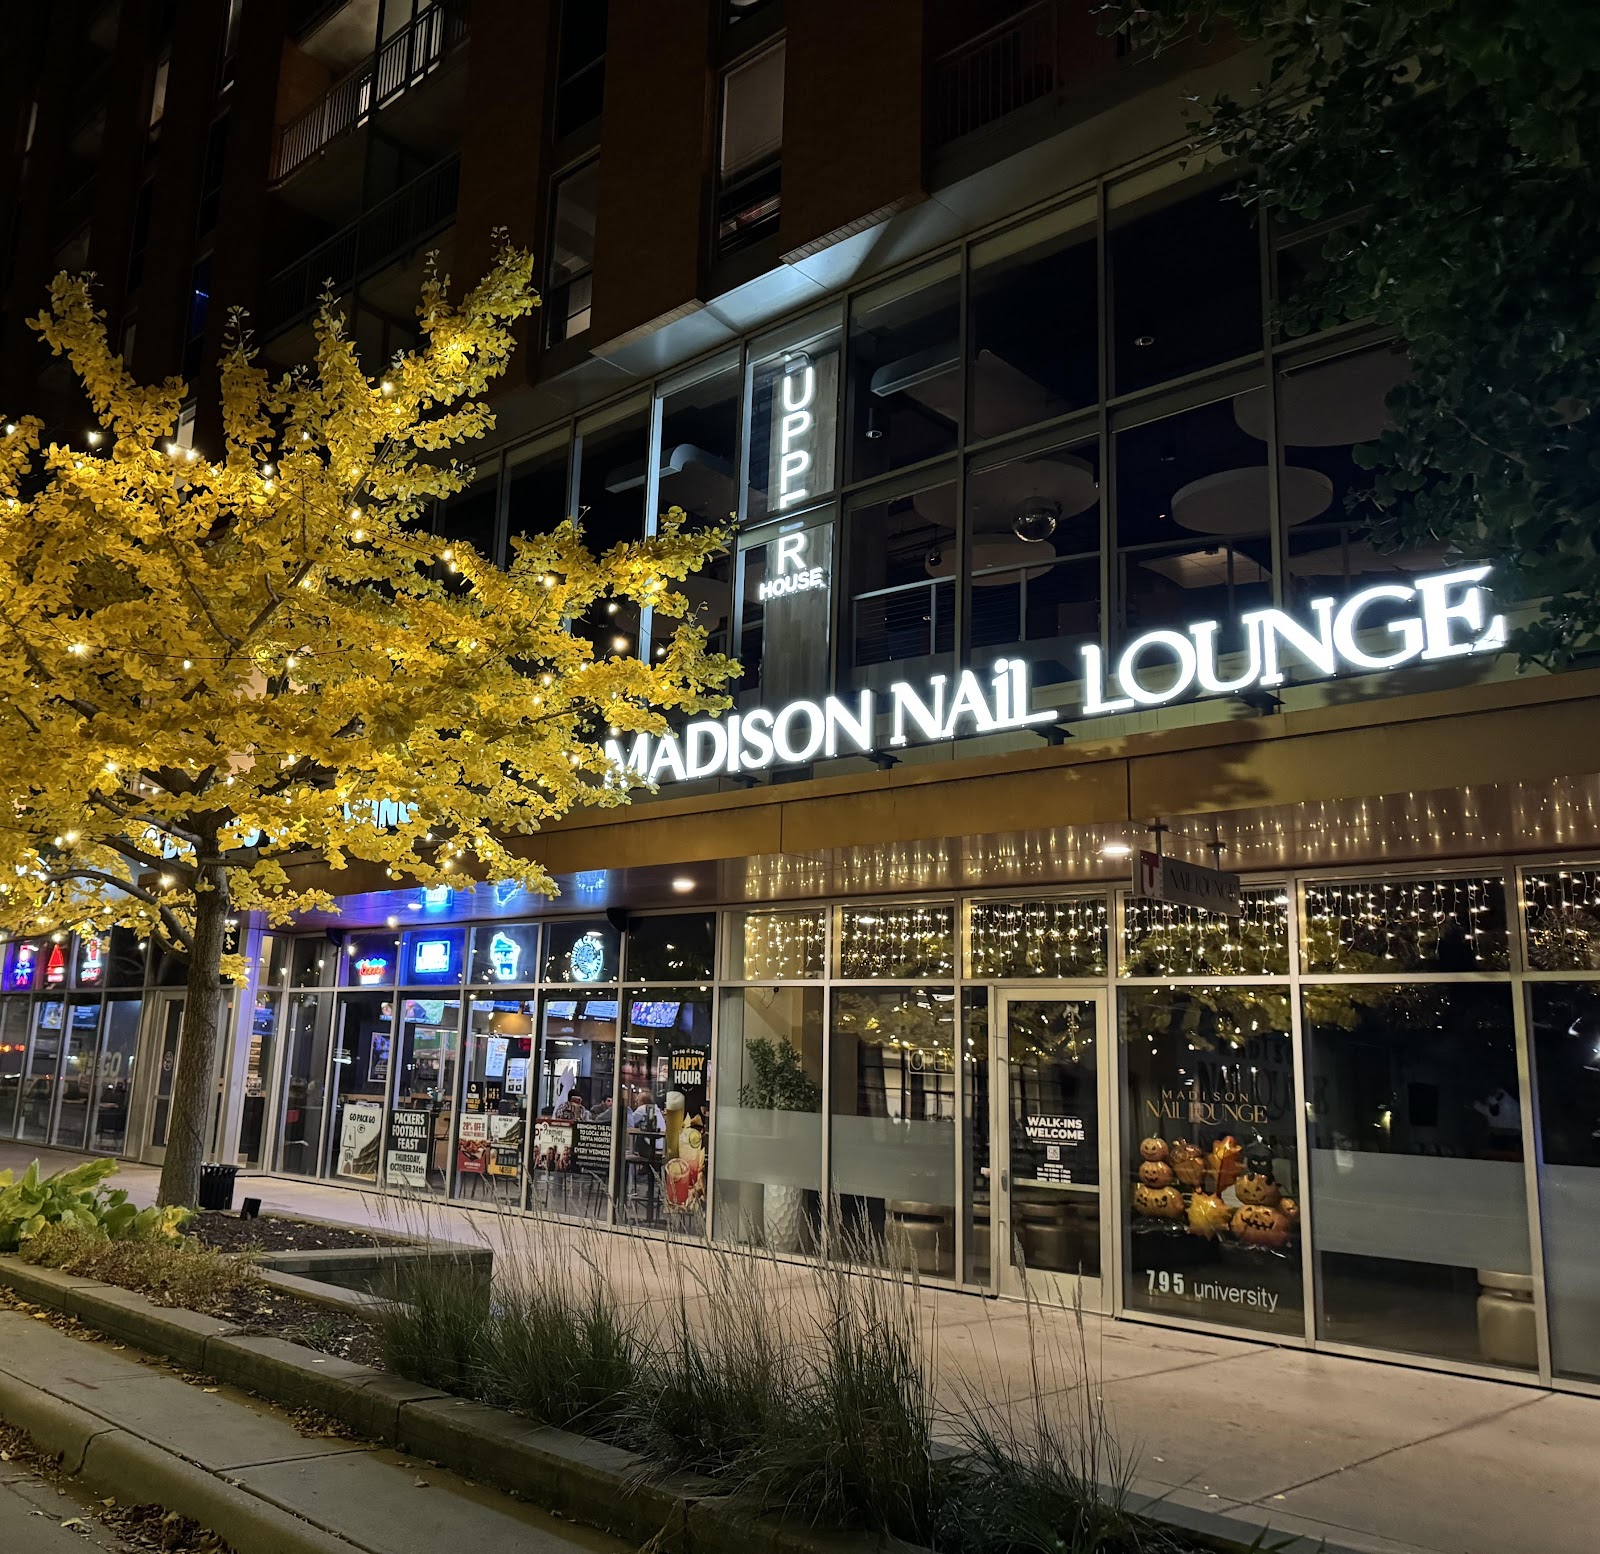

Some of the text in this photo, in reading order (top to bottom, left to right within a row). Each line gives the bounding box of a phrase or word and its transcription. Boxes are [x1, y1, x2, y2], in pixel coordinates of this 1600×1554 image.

[759, 567, 824, 601] HOUSE
[604, 686, 872, 789] MADISON
[1081, 565, 1505, 714] LOUNGE
[672, 1056, 705, 1071] HAPPY
[674, 1070, 701, 1085] HOUR
[1161, 1089, 1249, 1103] MADISON
[349, 1113, 376, 1124] GO PACK GO
[394, 1112, 425, 1126] PACKERS
[1188, 1101, 1268, 1126] LOUNGE
[474, 1122, 482, 1131] OFF
[577, 1123, 597, 1131] BRINGING
[1026, 1116, 1083, 1130] WALK-INS
[392, 1125, 427, 1138] FOOTBALL
[1025, 1126, 1085, 1141] WELCOME
[397, 1138, 419, 1151] FEAST
[551, 1135, 566, 1143] Trivia
[574, 1147, 588, 1155] EVERY
[395, 1153, 421, 1165] THURSDAY,
[389, 1162, 425, 1174] OCTOBER 24th
[1146, 1269, 1279, 1313] 795 university
